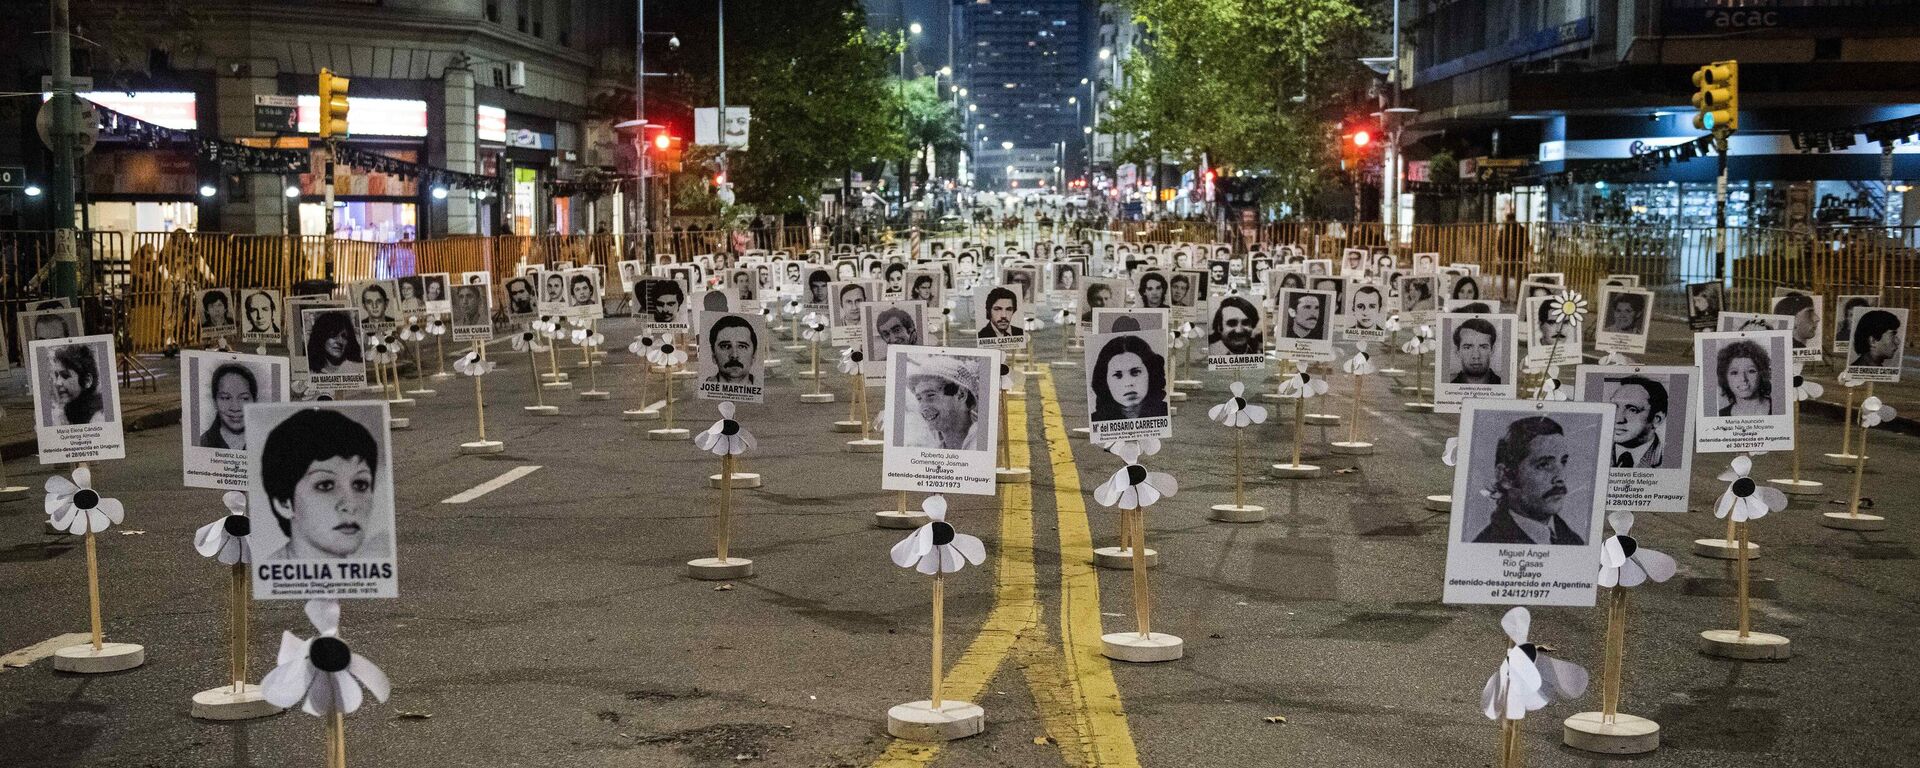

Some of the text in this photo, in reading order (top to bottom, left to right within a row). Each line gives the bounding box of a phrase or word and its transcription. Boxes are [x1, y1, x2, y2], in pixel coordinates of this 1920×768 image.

[1715, 10, 1777, 27] acac
[1208, 356, 1227, 364] RAÚL
[700, 382, 761, 395] JOSÉ MARTÍNEZ
[1110, 421, 1134, 431] ROSARIO
[1135, 419, 1168, 429] CARRETERO
[187, 470, 248, 478] detenida-desaparecid
[888, 472, 954, 480] detenido-desaparecido
[1499, 549, 1550, 559] Miguel Ángel
[258, 563, 392, 580] CECILIA TRIAS
[1503, 570, 1542, 578] Uruguayo
[1449, 579, 1539, 588] detenido-desaparecido
[1553, 581, 1593, 589] Argentina:
[1502, 590, 1550, 598] 24/12/1977
